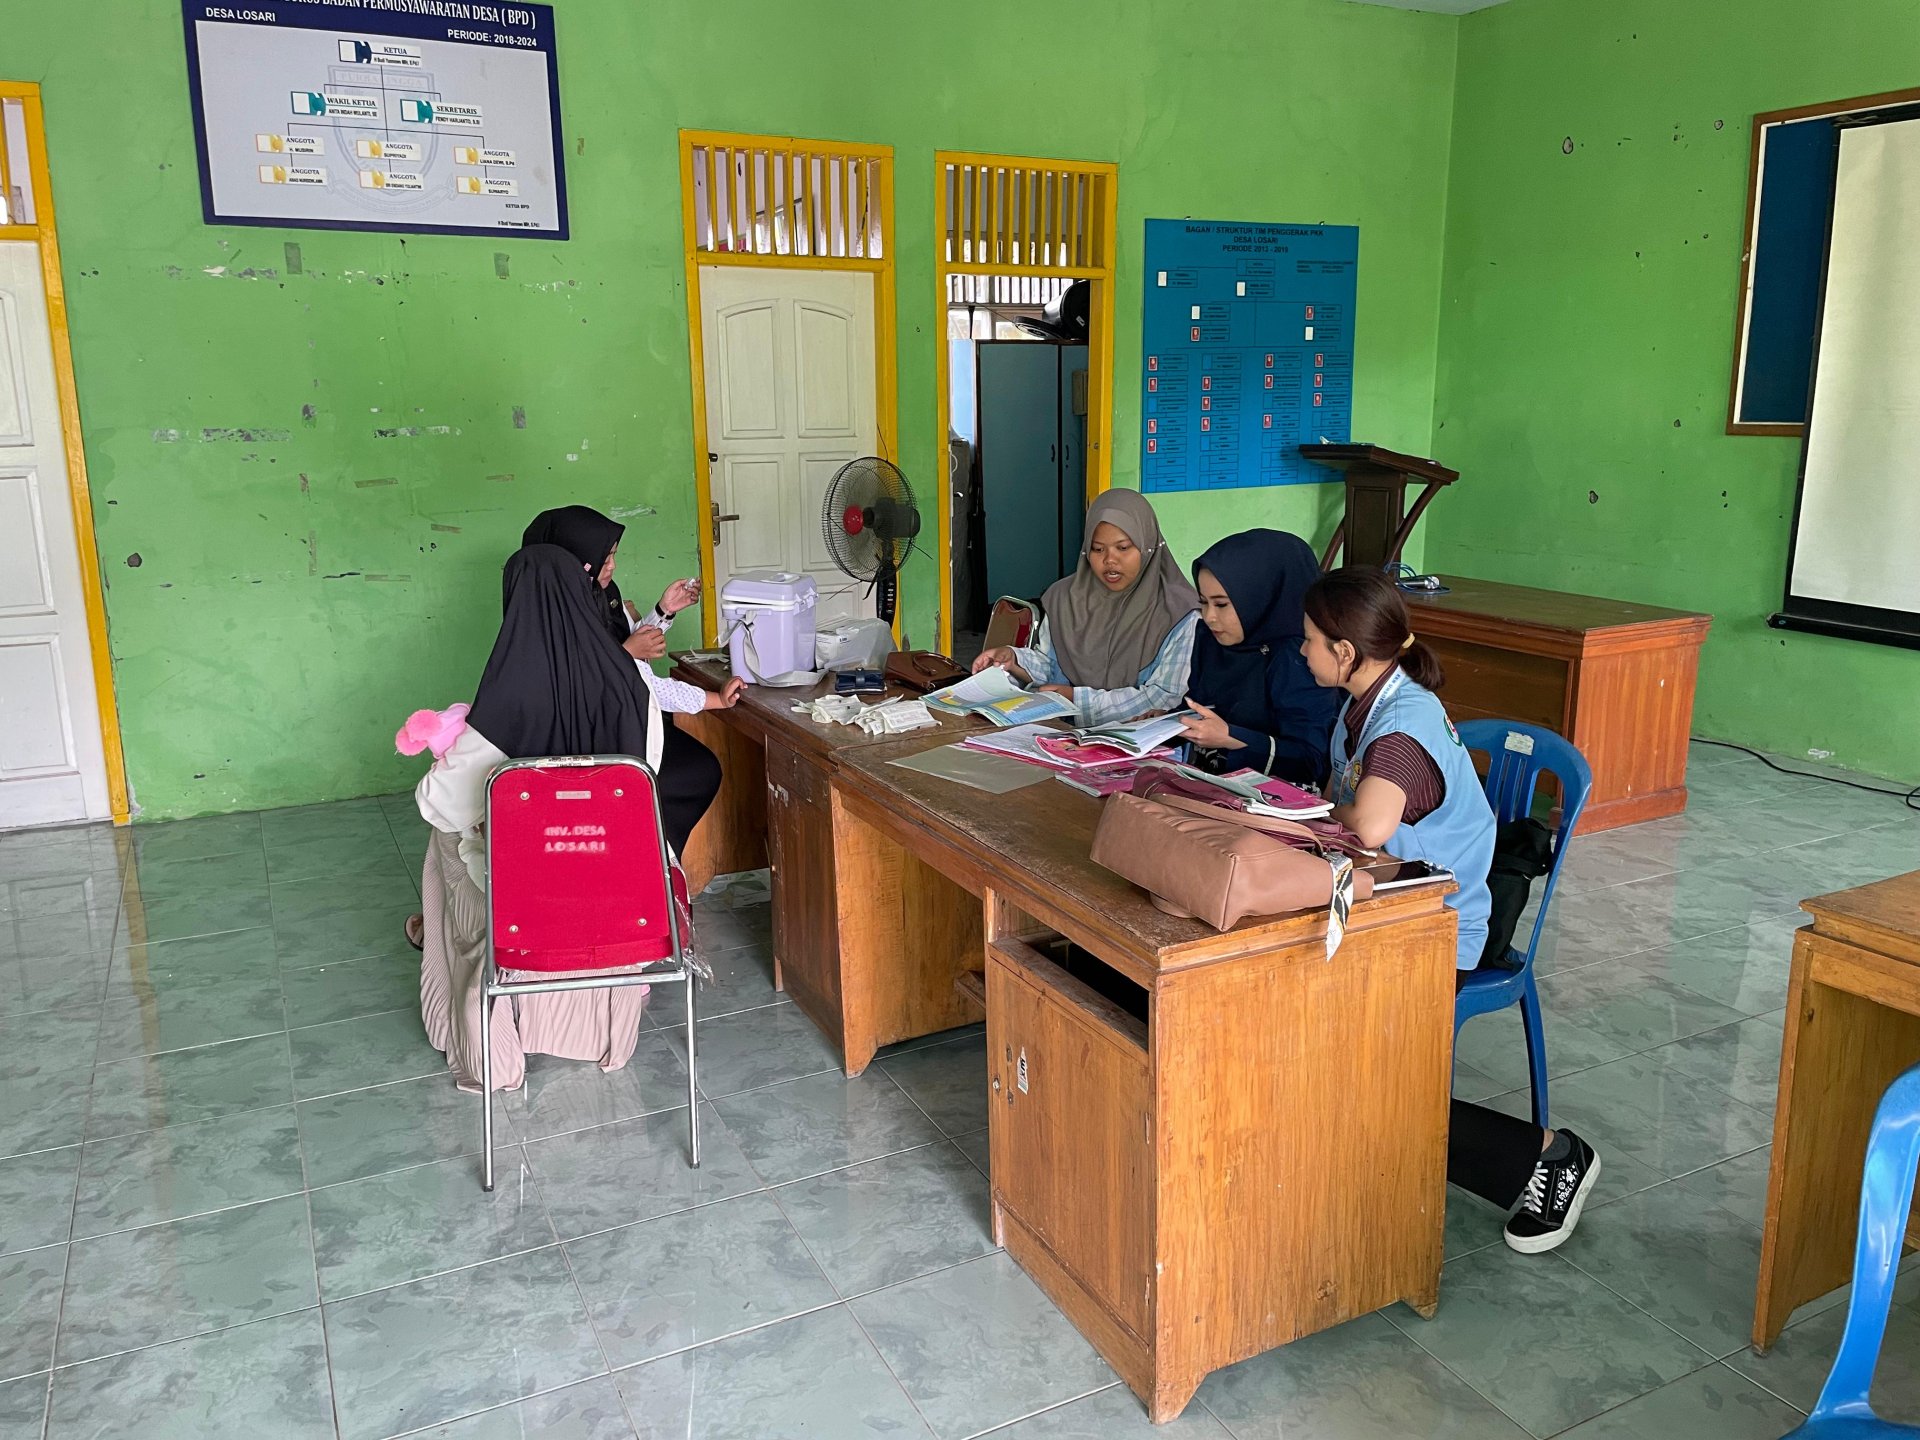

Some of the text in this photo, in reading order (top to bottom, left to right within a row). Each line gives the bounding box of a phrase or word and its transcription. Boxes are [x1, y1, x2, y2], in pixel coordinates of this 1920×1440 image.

[205, 7, 276, 22] DESA LOSARI
[364, 0, 471, 19] PERMUSYAWARATAN
[473, 5, 500, 23] DESA
[508, 9, 529, 26] BPD
[448, 29, 537, 47] PERIODE: 2018-2024
[384, 46, 408, 55] KETUA
[327, 97, 377, 107] WAKIL KETUA
[436, 105, 478, 115] SEKRETARIS
[286, 137, 316, 145] ANGGOTA
[385, 143, 413, 151] ANGGOTA
[483, 150, 511, 158] ANGGOTA
[290, 168, 320, 176] ANGGOTA
[389, 173, 417, 181] ANGGOTA
[485, 179, 512, 187] ANGGOTA
[1185, 225, 1211, 233] BAGAN
[1216, 226, 1253, 235] STRUKTUR
[1267, 228, 1309, 236] PENGGERAK
[1310, 229, 1324, 237] PKK
[1233, 236, 1253, 244] DESA
[1222, 244, 1252, 253] PERIODE
[544, 825, 607, 837] INV. DESA
[544, 841, 607, 853] LOSARI
